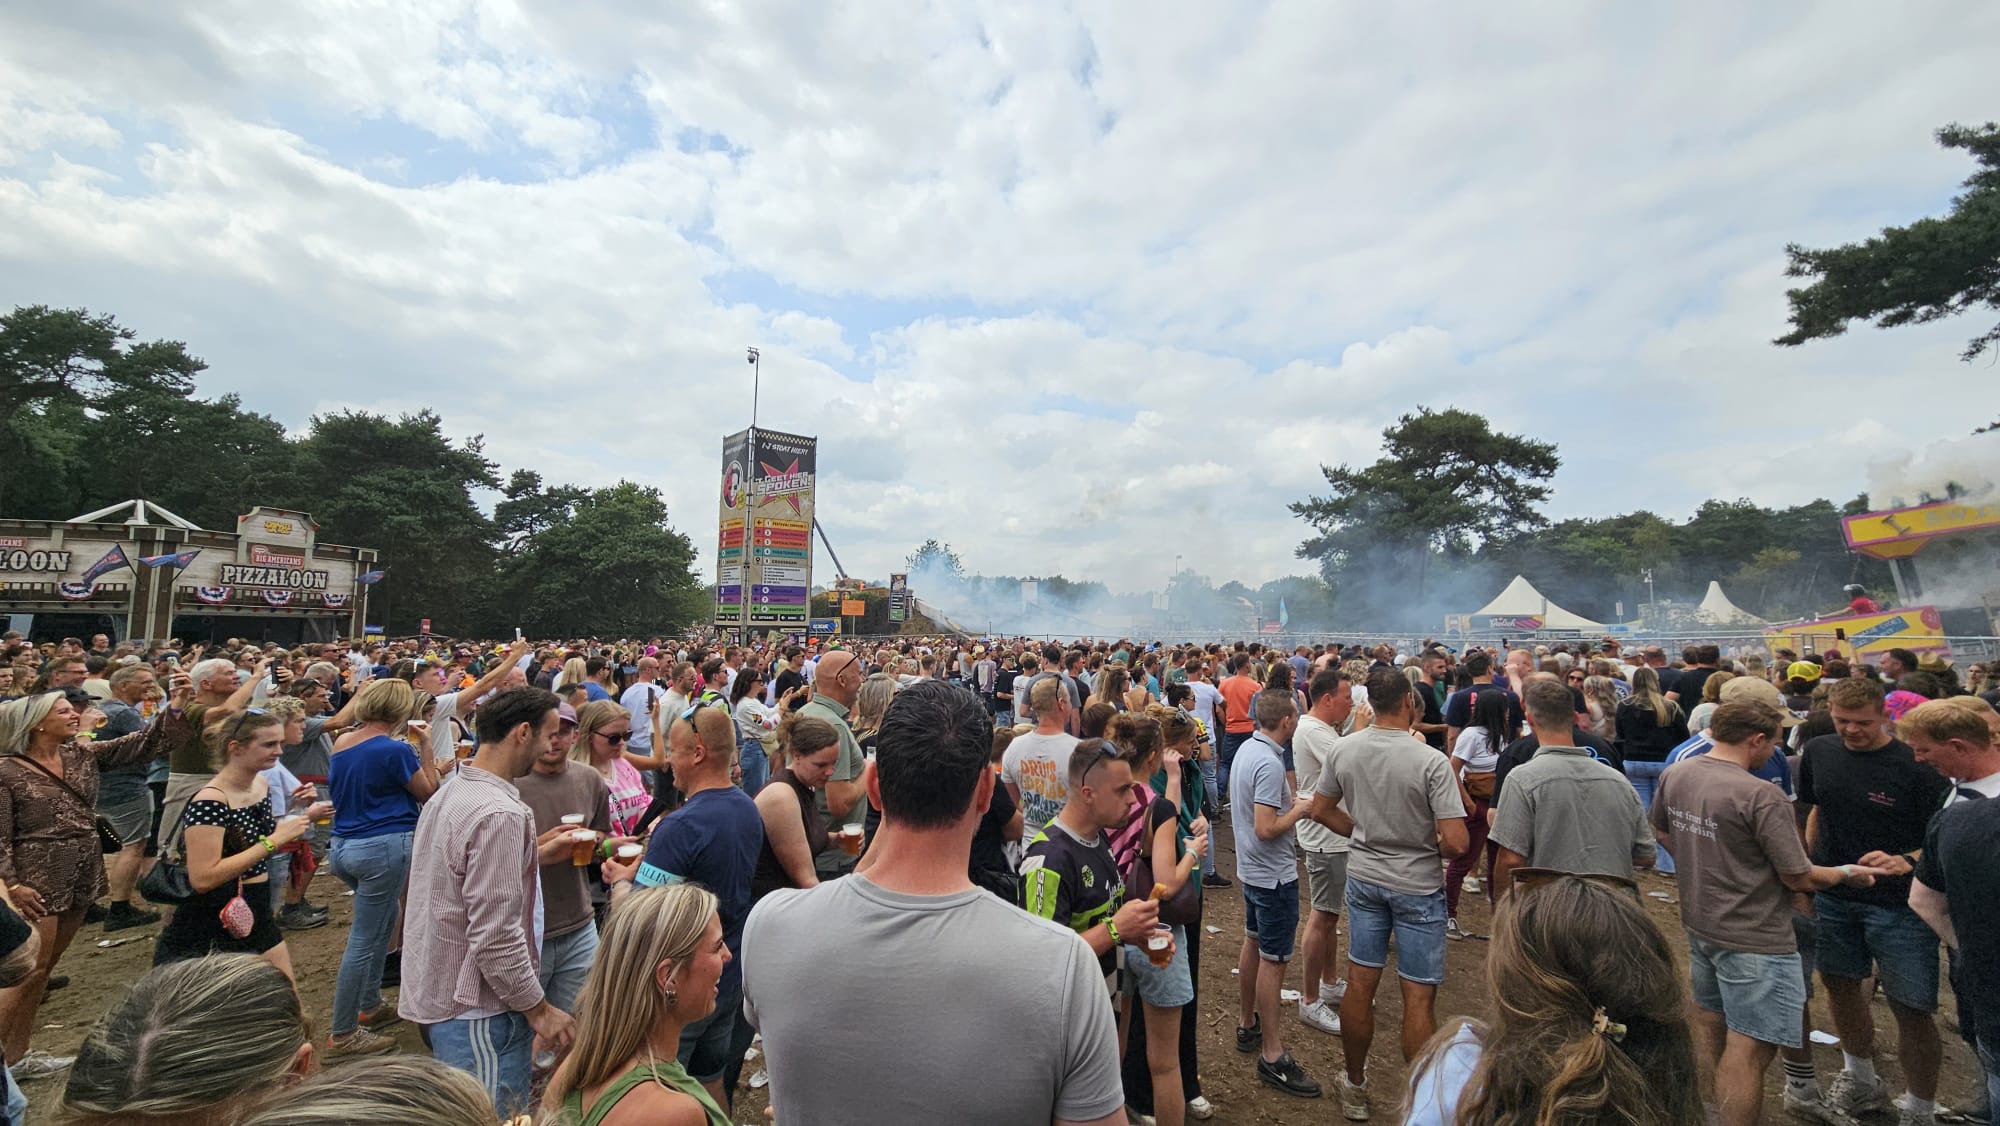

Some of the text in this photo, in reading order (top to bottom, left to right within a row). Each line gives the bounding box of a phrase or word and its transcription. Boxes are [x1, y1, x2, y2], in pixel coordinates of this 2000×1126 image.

[757, 477, 811, 496] SPOKEN!
[268, 555, 301, 566] AMERICANS
[222, 564, 328, 589] PIZZALOON
